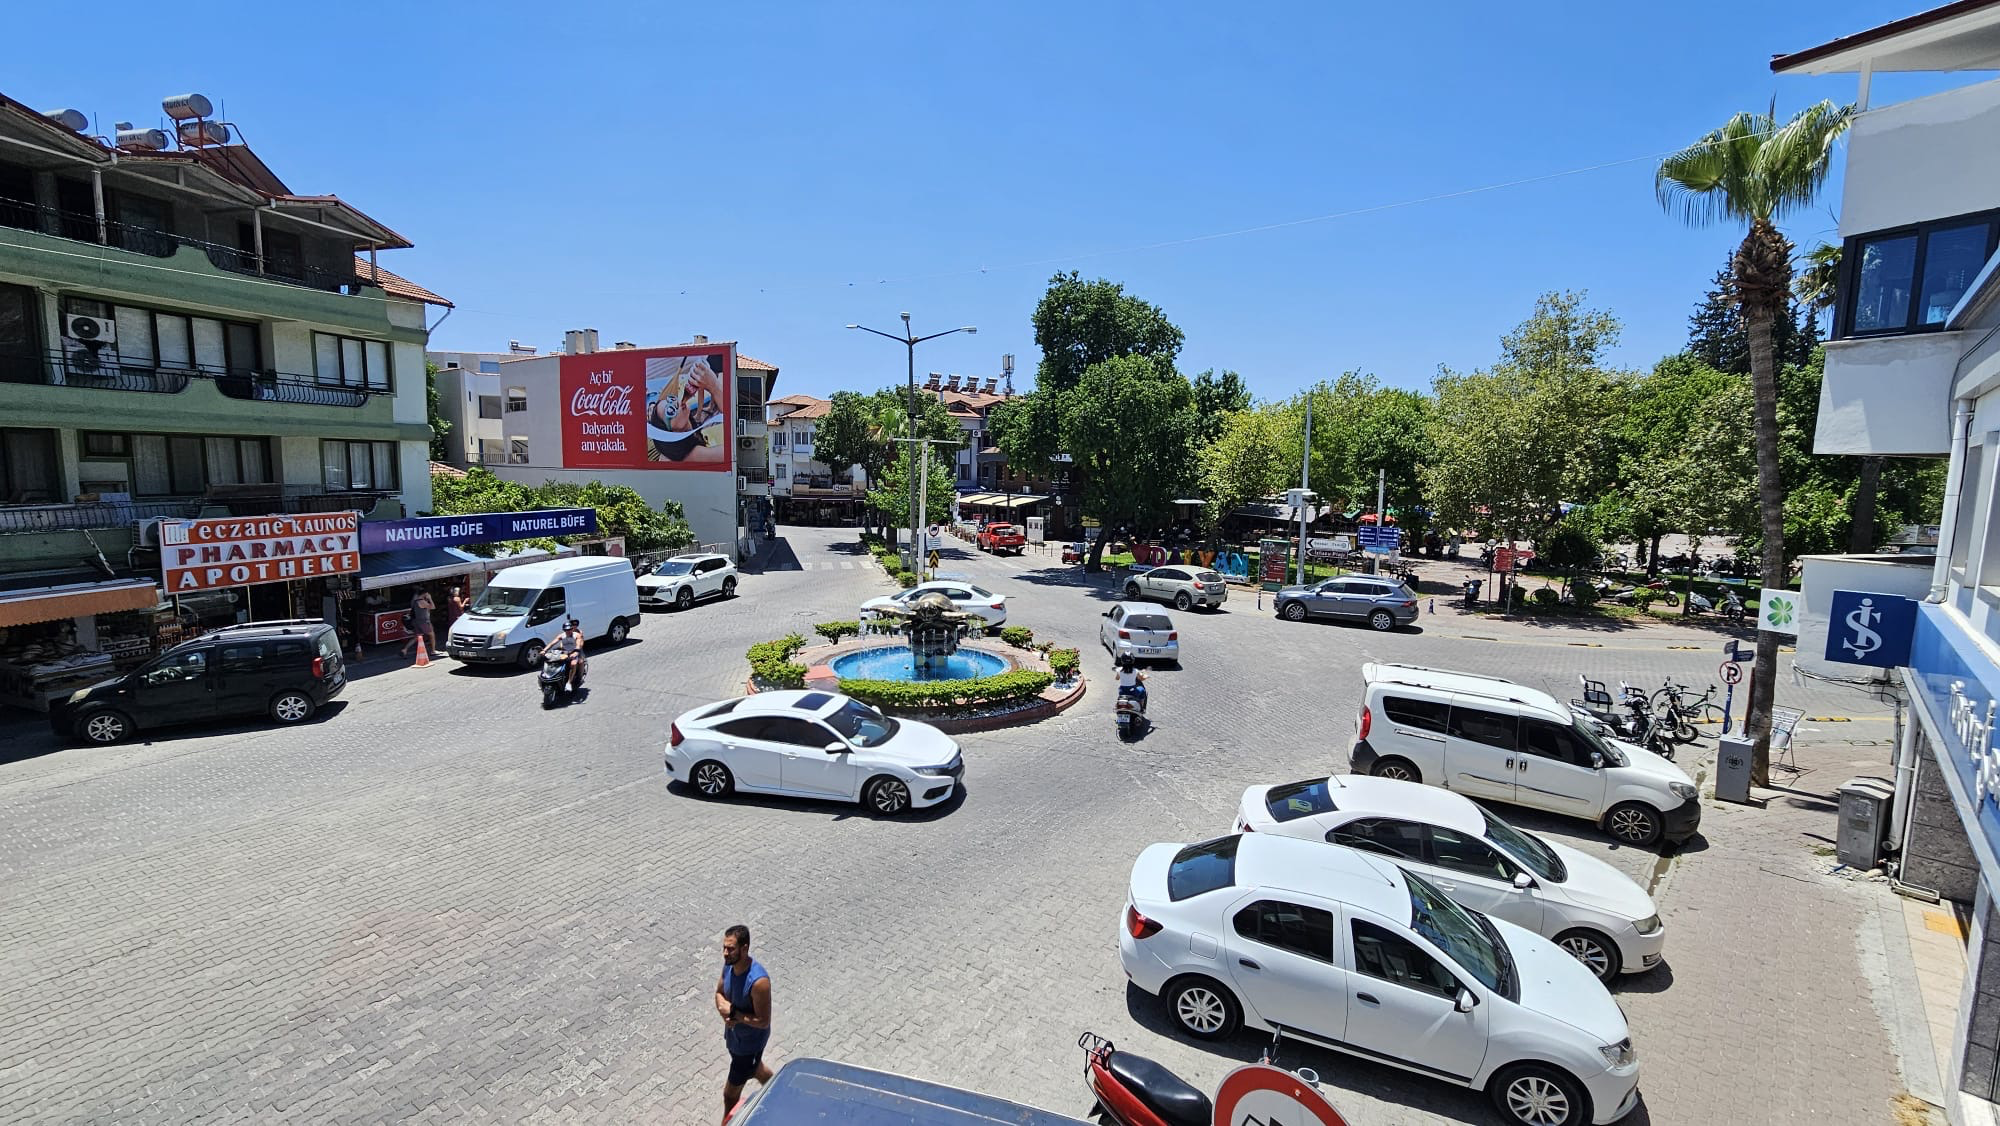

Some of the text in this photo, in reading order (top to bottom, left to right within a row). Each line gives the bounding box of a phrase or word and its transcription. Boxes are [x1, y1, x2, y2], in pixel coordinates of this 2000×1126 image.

[590, 371, 602, 386] Aç
[571, 385, 634, 416] Coca-Cola
[582, 421, 625, 437] Dalyan'da
[581, 440, 595, 452] anı
[198, 516, 356, 540] eczane KAUNOS
[385, 514, 586, 542] NATUREL BÜFE NATUREL BÜFE
[177, 535, 352, 566] PHARMACY
[178, 554, 353, 589] APOTHEKE
